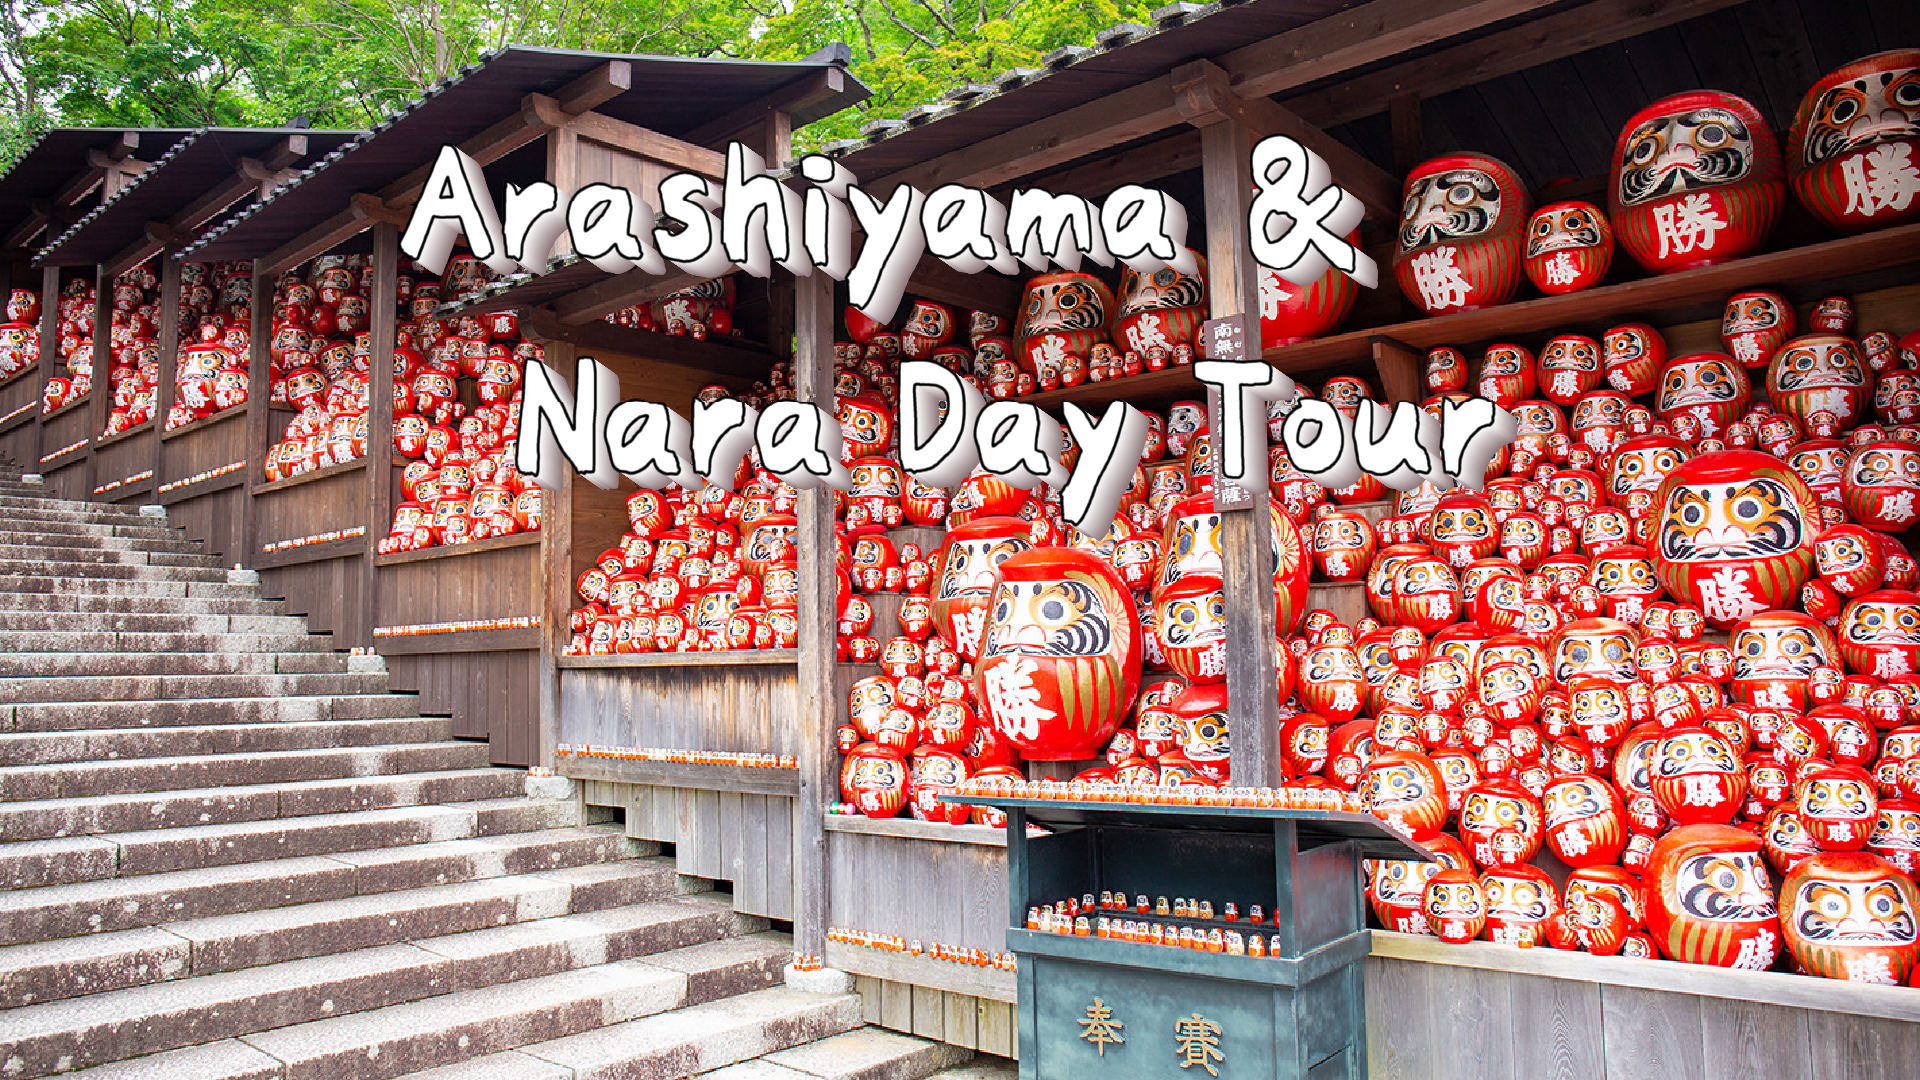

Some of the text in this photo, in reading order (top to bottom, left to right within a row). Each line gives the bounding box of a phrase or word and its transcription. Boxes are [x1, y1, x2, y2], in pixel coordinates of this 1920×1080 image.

[1843, 142, 1920, 215] 勝
[1653, 193, 1728, 259] 勝
[1412, 247, 1472, 310] 勝
[1546, 253, 1581, 286] 勝
[1126, 313, 1173, 356] 勝
[1876, 490, 1915, 522] 勝
[1696, 567, 1770, 621] 勝
[1872, 648, 1912, 679] 勝
[983, 651, 1057, 741] 勝
[1682, 774, 1727, 807] 勝
